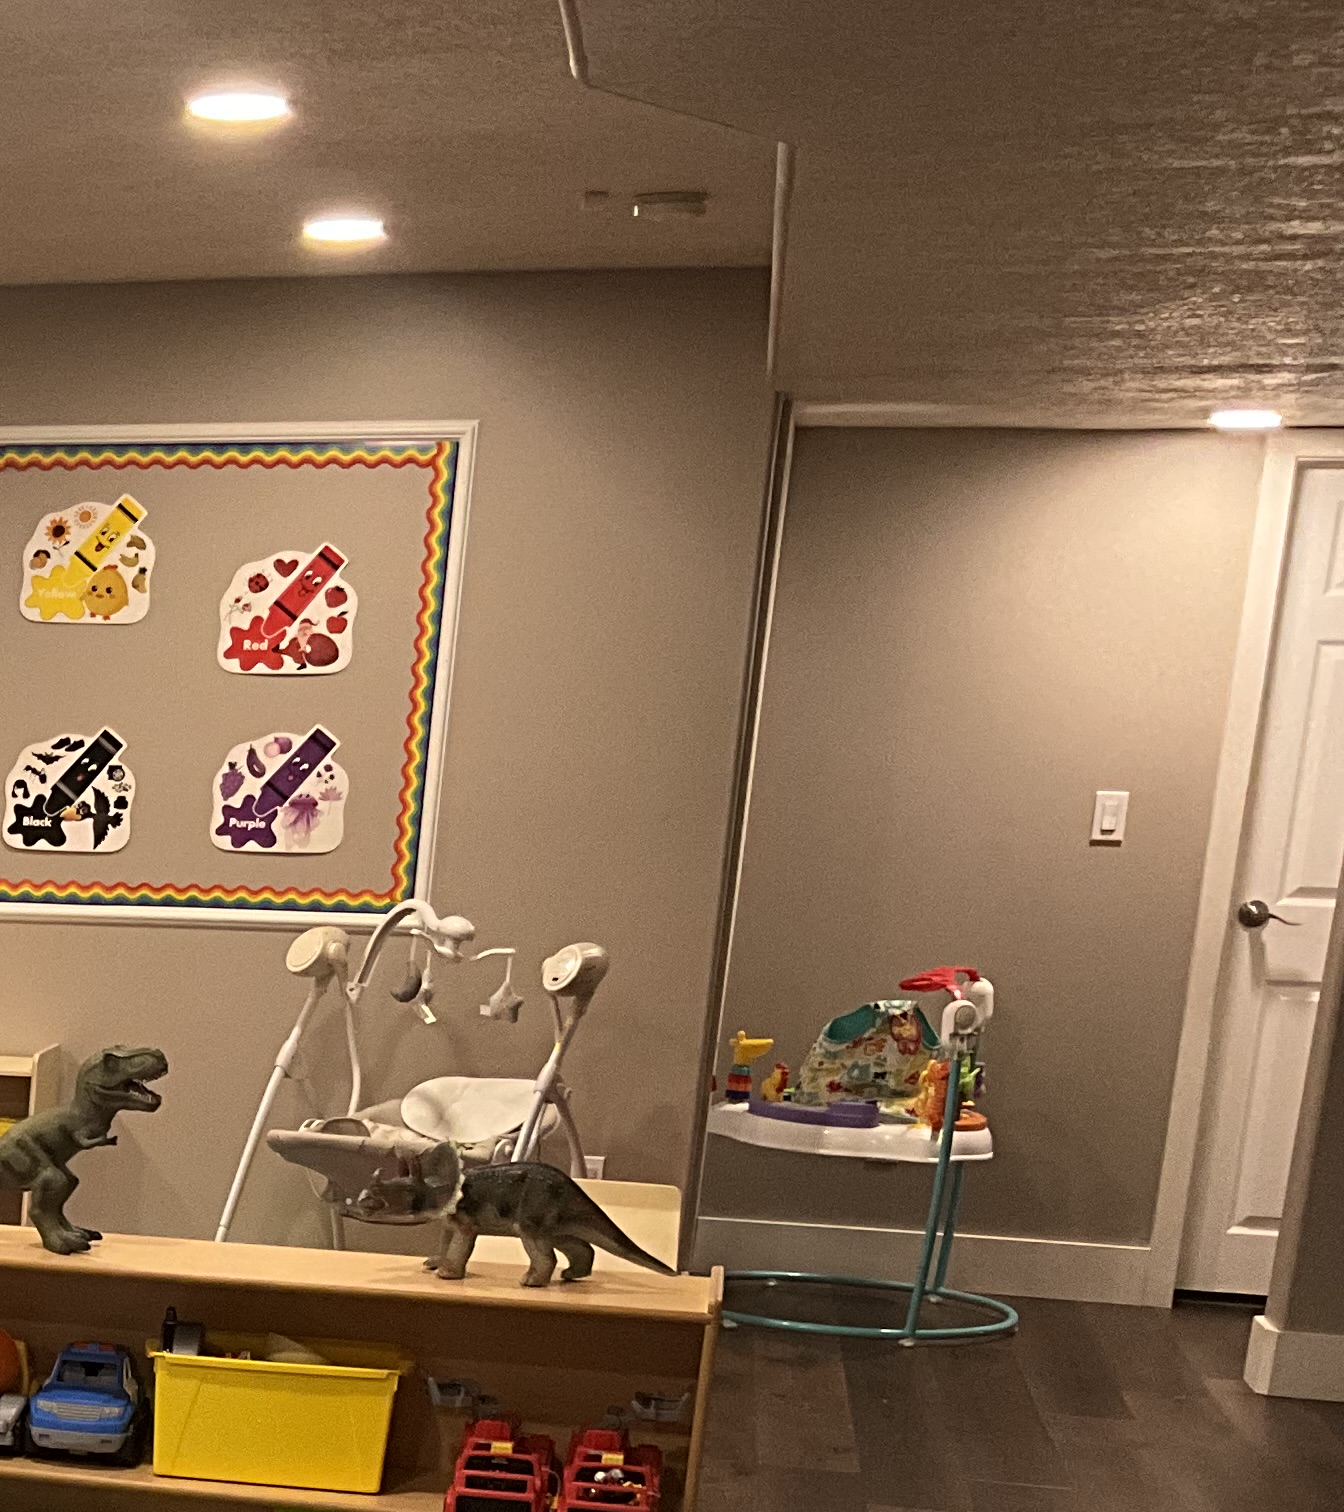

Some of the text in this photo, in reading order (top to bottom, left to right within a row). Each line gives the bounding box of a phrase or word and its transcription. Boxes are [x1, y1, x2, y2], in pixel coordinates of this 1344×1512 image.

[243, 639, 269, 651] Red
[23, 816, 52, 828] Black
[229, 817, 266, 831] Purple
